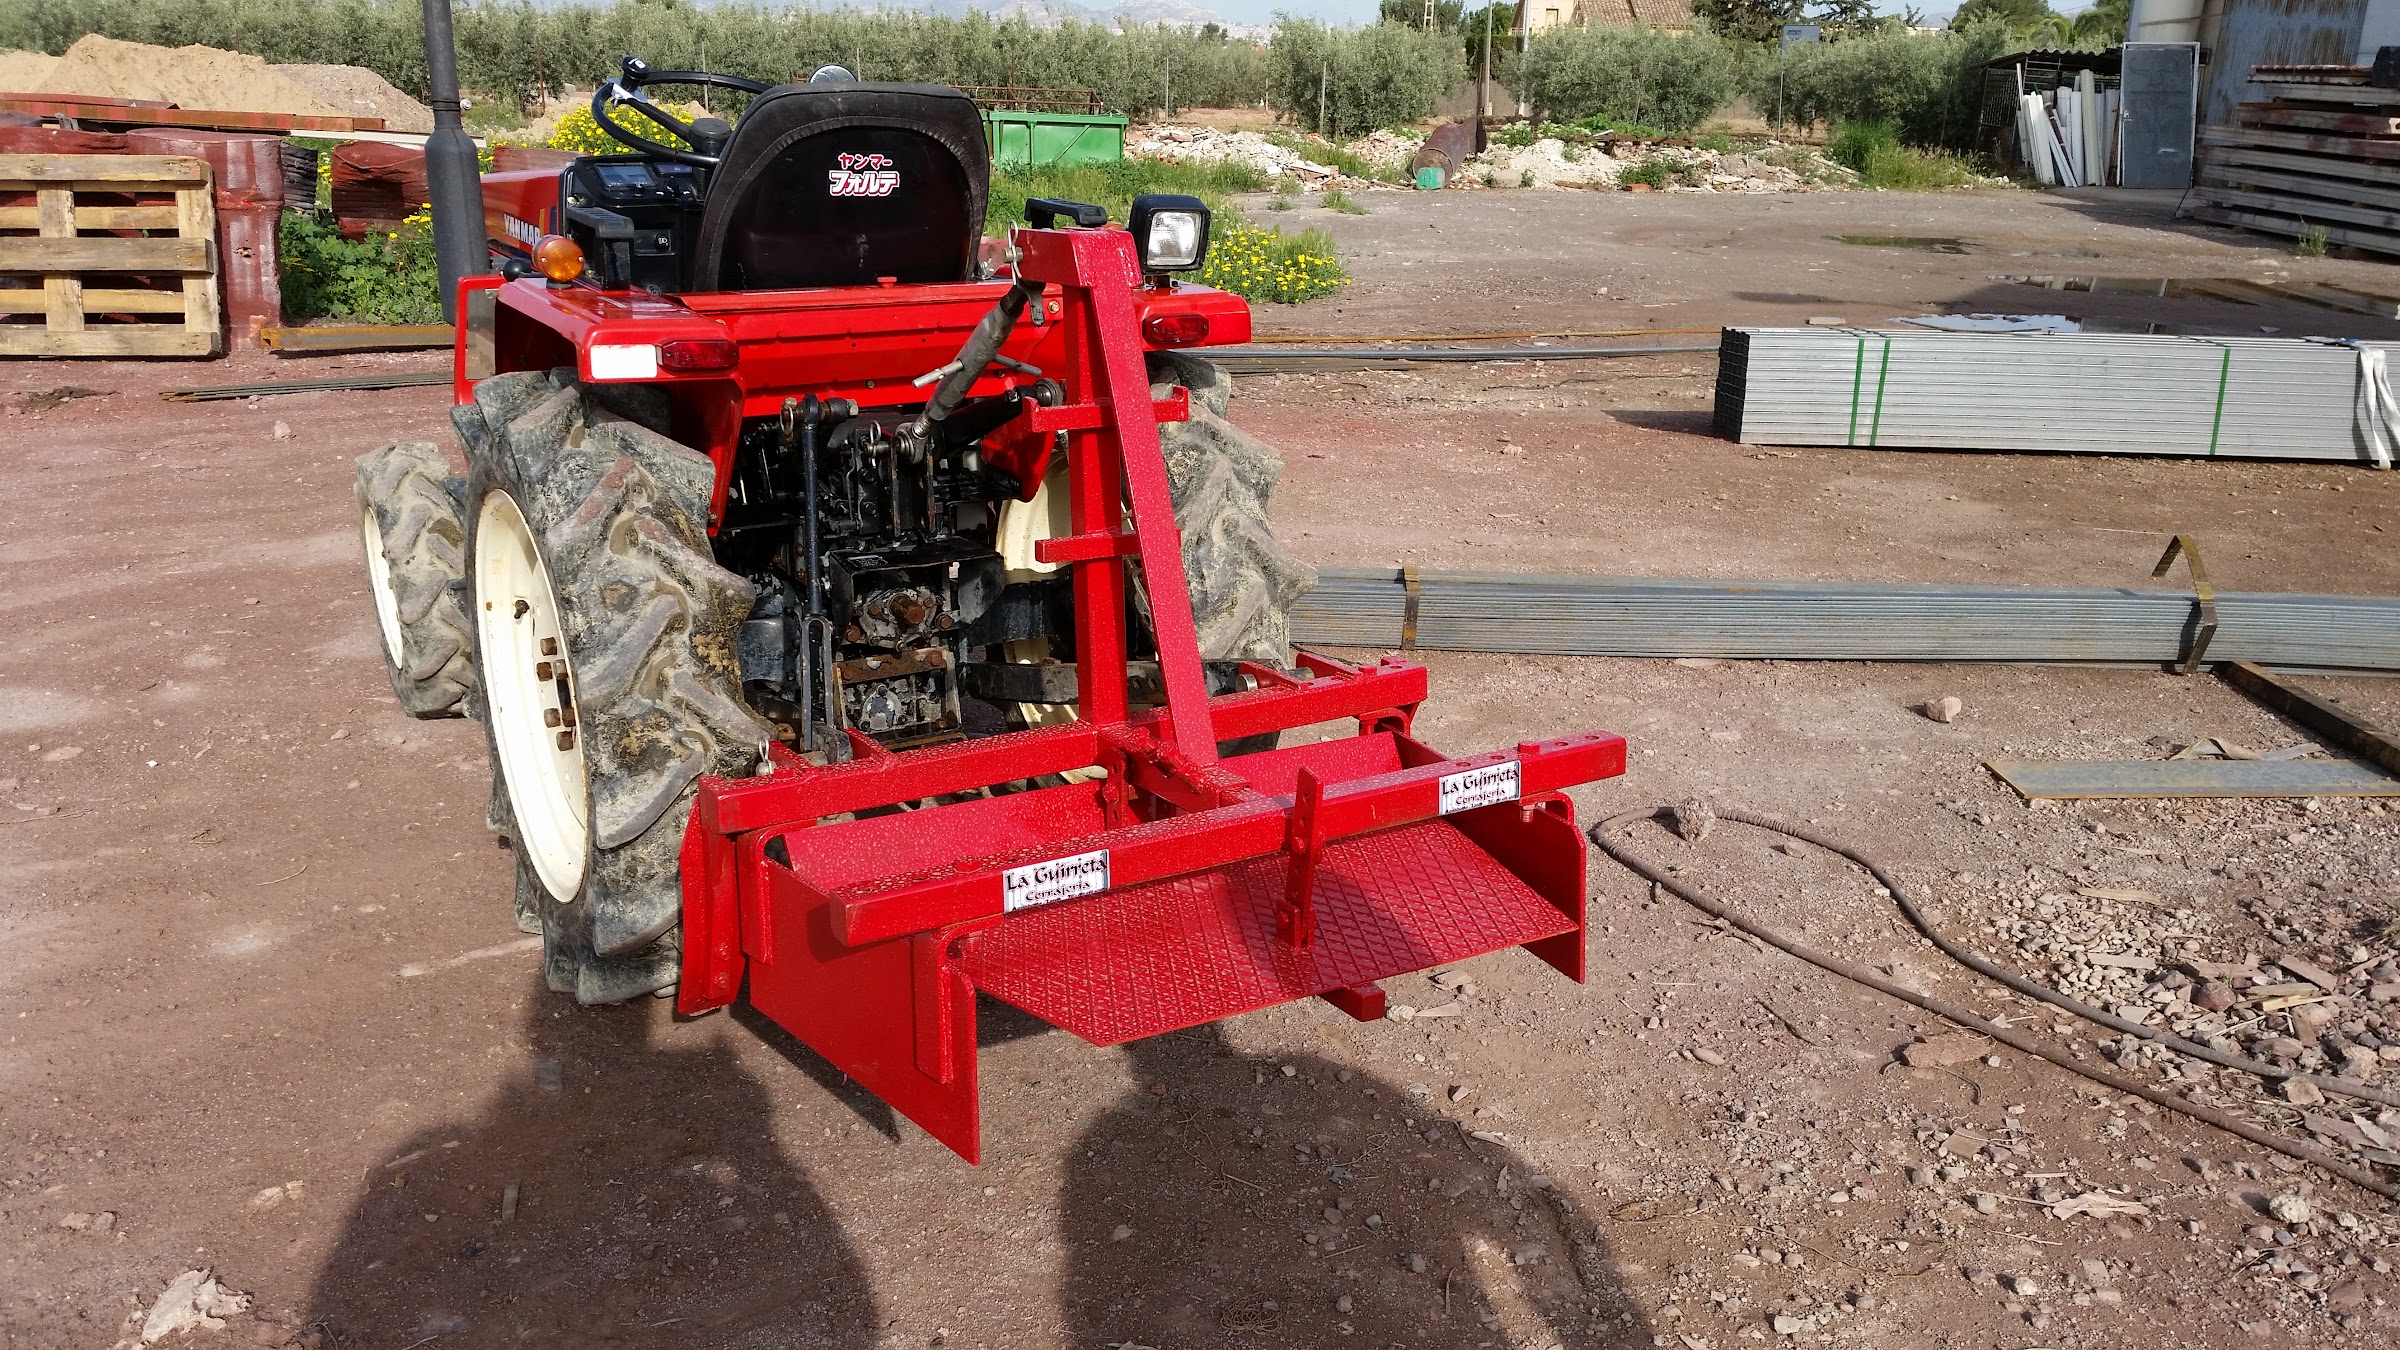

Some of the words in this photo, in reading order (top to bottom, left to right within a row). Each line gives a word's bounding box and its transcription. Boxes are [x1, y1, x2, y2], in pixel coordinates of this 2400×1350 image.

[838, 153, 893, 170] ヤンマー
[829, 170, 901, 196] フォルテ
[1463, 768, 1519, 790] Guirreta
[1034, 858, 1107, 884] Guirreta
